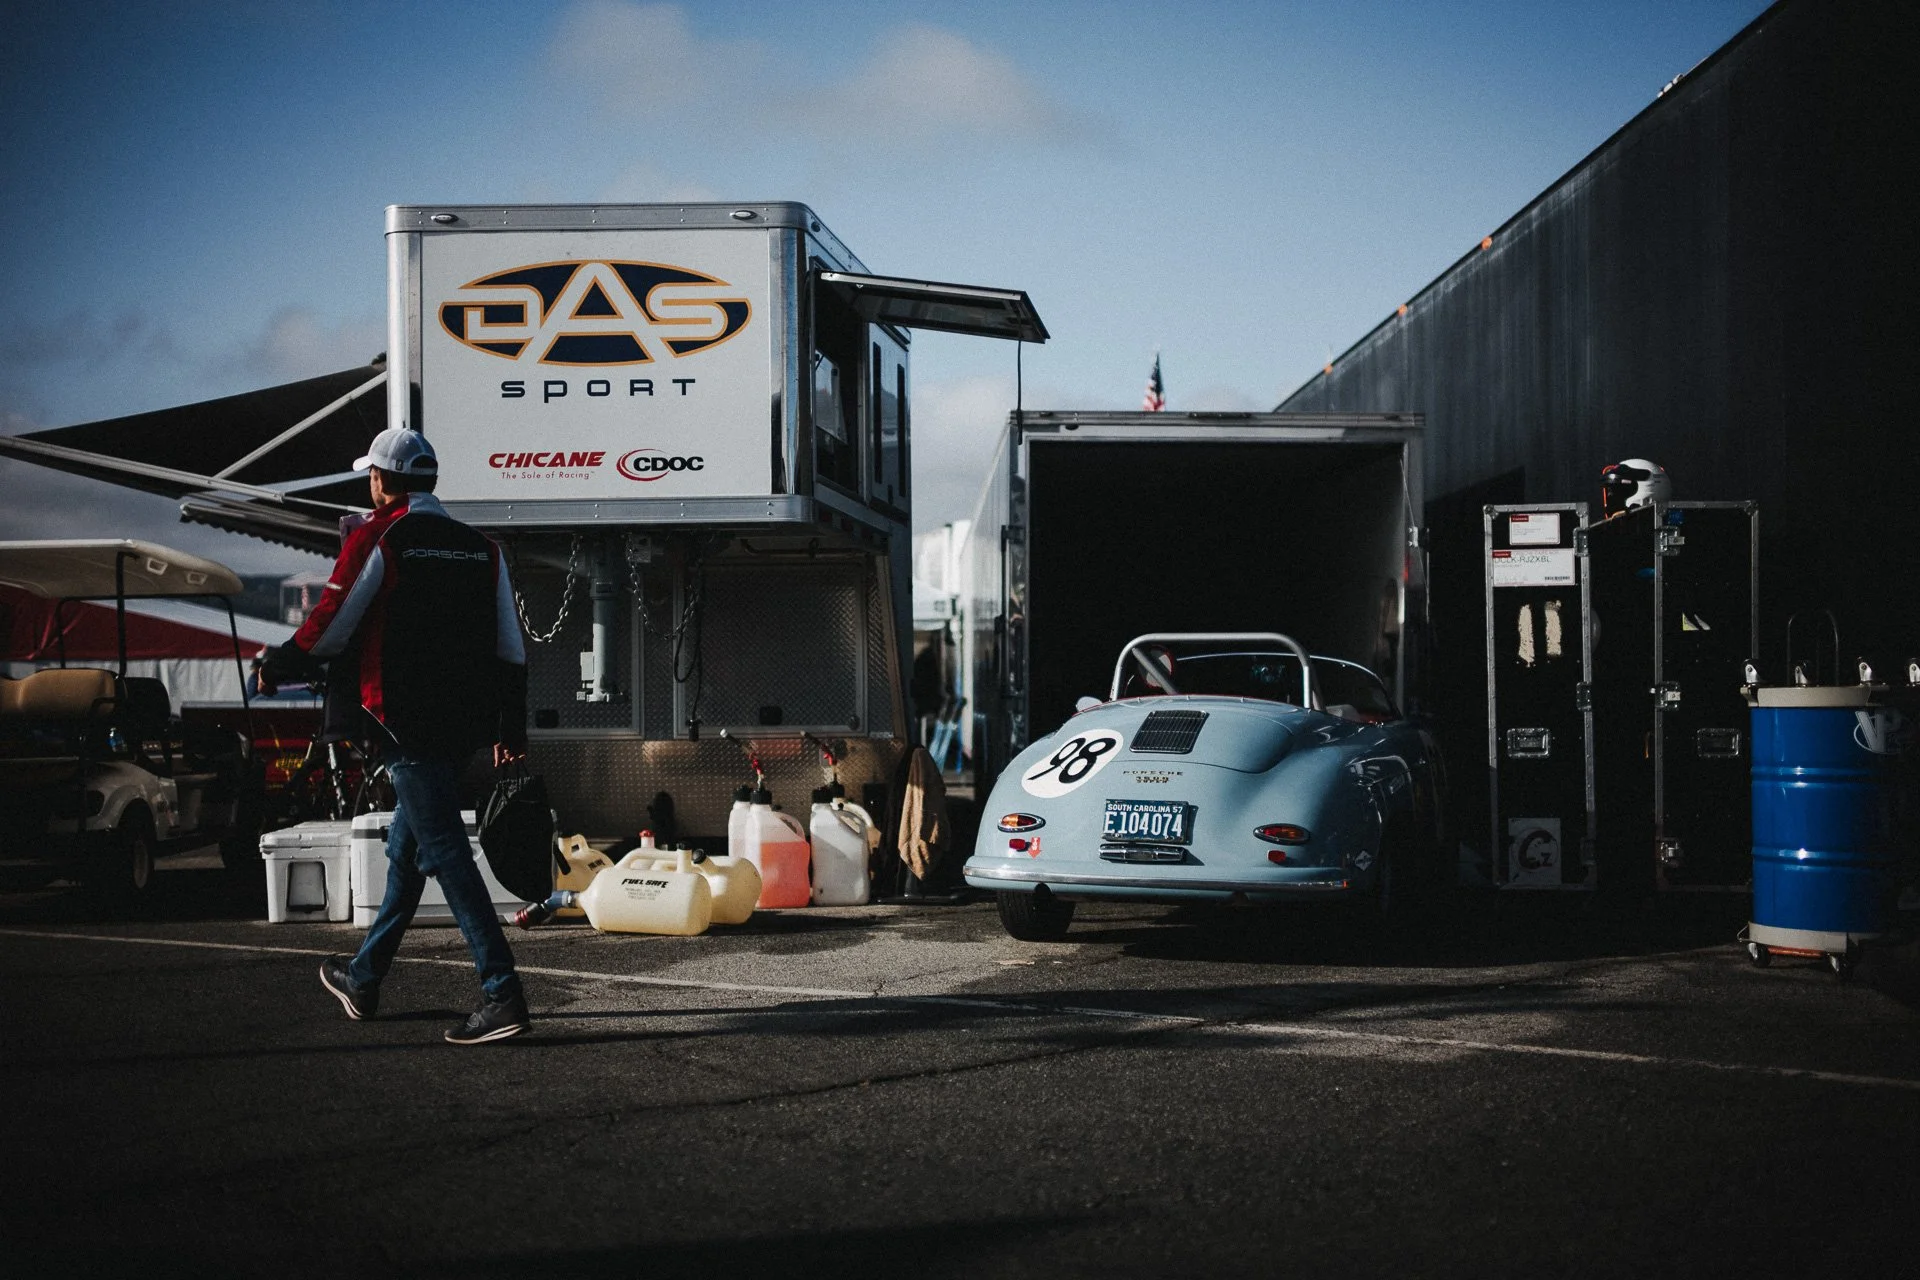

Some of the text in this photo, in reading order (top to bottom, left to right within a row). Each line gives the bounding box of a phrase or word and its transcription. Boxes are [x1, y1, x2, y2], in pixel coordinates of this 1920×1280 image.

[488, 451, 606, 469] CHICANE
[633, 456, 704, 471] CDOC
[501, 472, 517, 480] The
[521, 471, 541, 479] Sole
[545, 471, 555, 479] of
[402, 549, 489, 561] PORSCHE
[1026, 737, 1117, 784] 98
[1107, 803, 1132, 811] SOUTH
[1133, 804, 1170, 812] CAROLINA
[1103, 810, 1183, 837] E104074
[621, 878, 644, 887] FUEL
